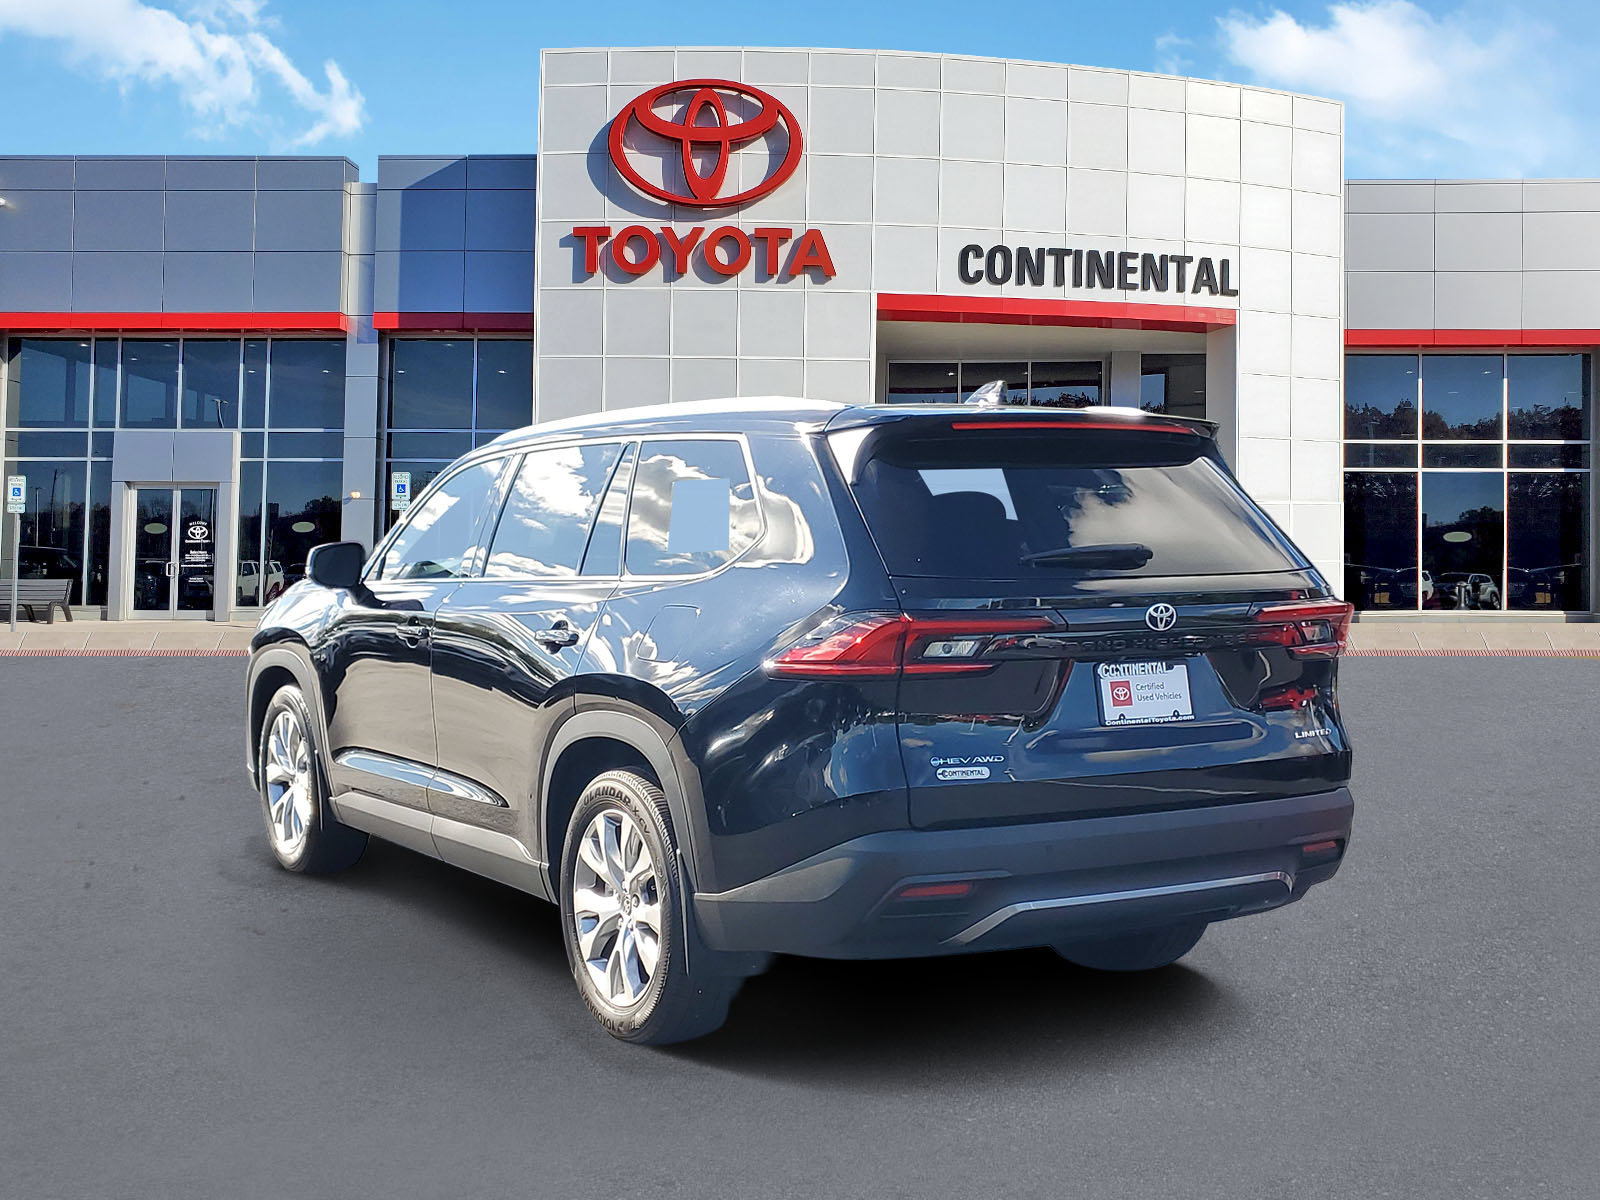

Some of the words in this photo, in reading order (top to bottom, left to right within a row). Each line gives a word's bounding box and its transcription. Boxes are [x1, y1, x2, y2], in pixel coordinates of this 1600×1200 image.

[572, 225, 837, 277] TOYOTA
[958, 244, 1239, 297] CONTINENTAL
[1099, 661, 1168, 678] CONTINENTAL
[1135, 682, 1165, 692] Certified
[1137, 693, 1154, 703] Used
[1155, 691, 1182, 701] Vehicles
[1105, 714, 1195, 726] ContinentalToyota.com
[1294, 727, 1332, 739] LIMITED
[971, 755, 1005, 764] AWD
[940, 769, 985, 778] CONTINENTAL
[581, 785, 631, 809] OLANDAR
